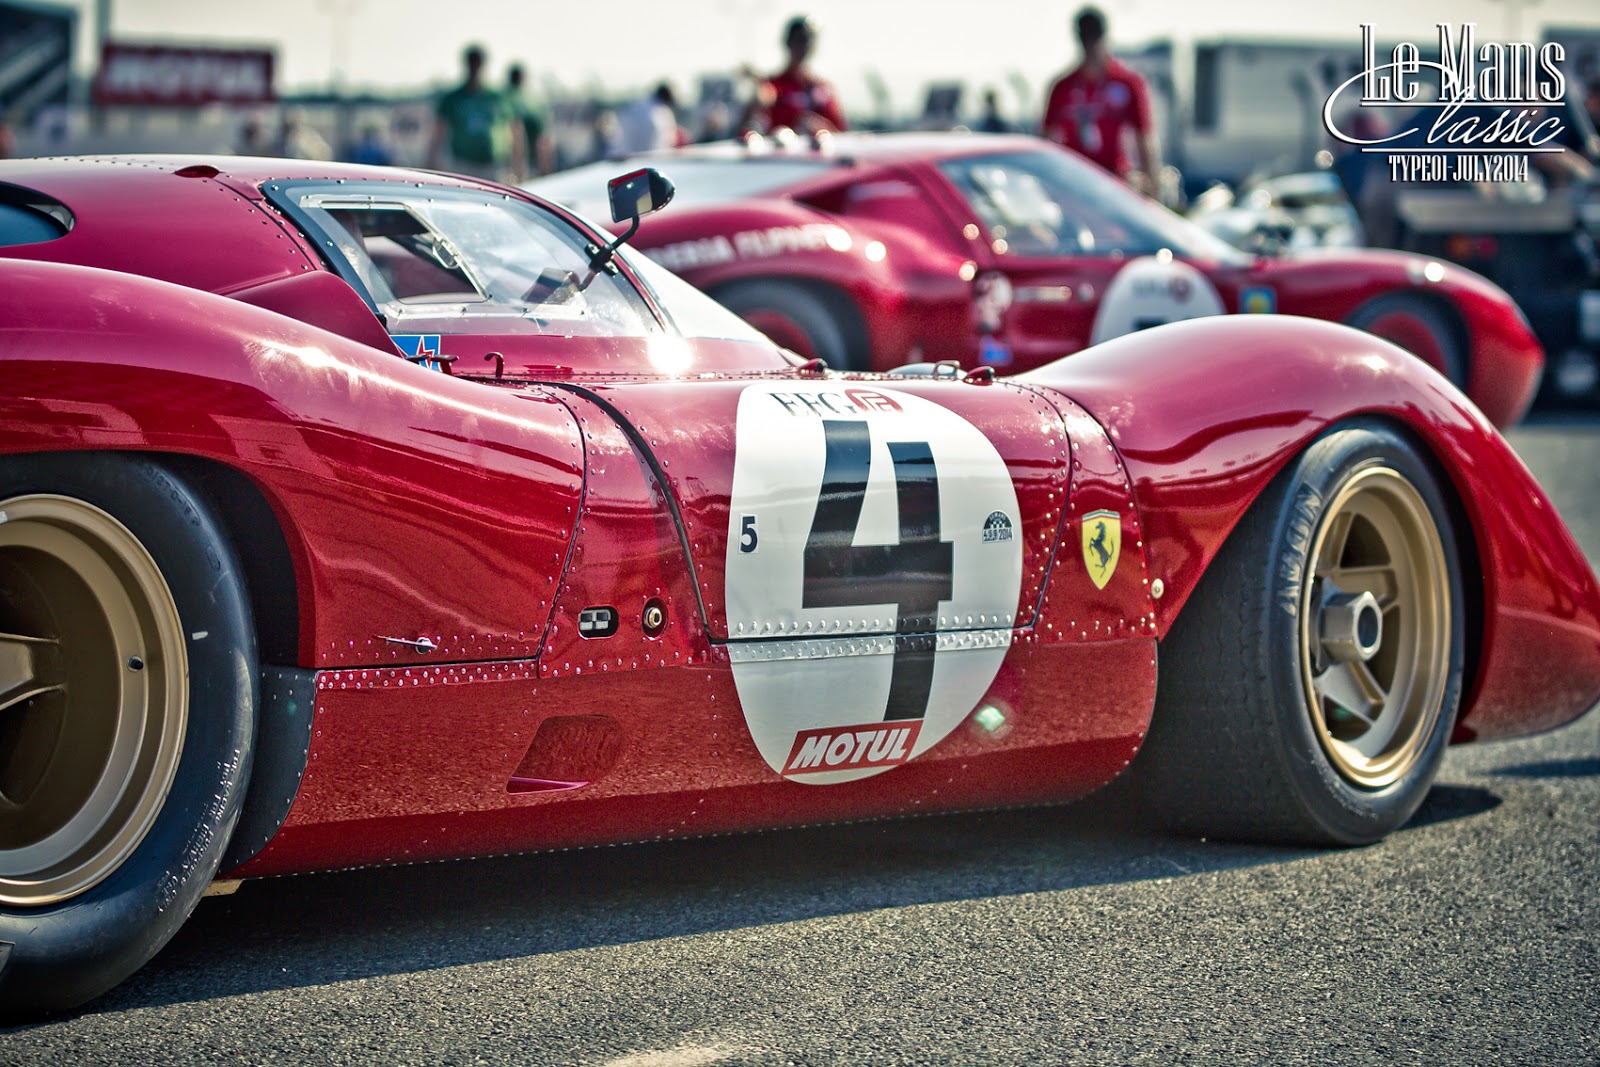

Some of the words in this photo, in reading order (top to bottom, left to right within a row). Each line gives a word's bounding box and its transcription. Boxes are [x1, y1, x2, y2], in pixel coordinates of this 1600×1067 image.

[740, 515, 758, 553] 5
[802, 419, 955, 722] 4
[789, 728, 911, 770] MOTUL
